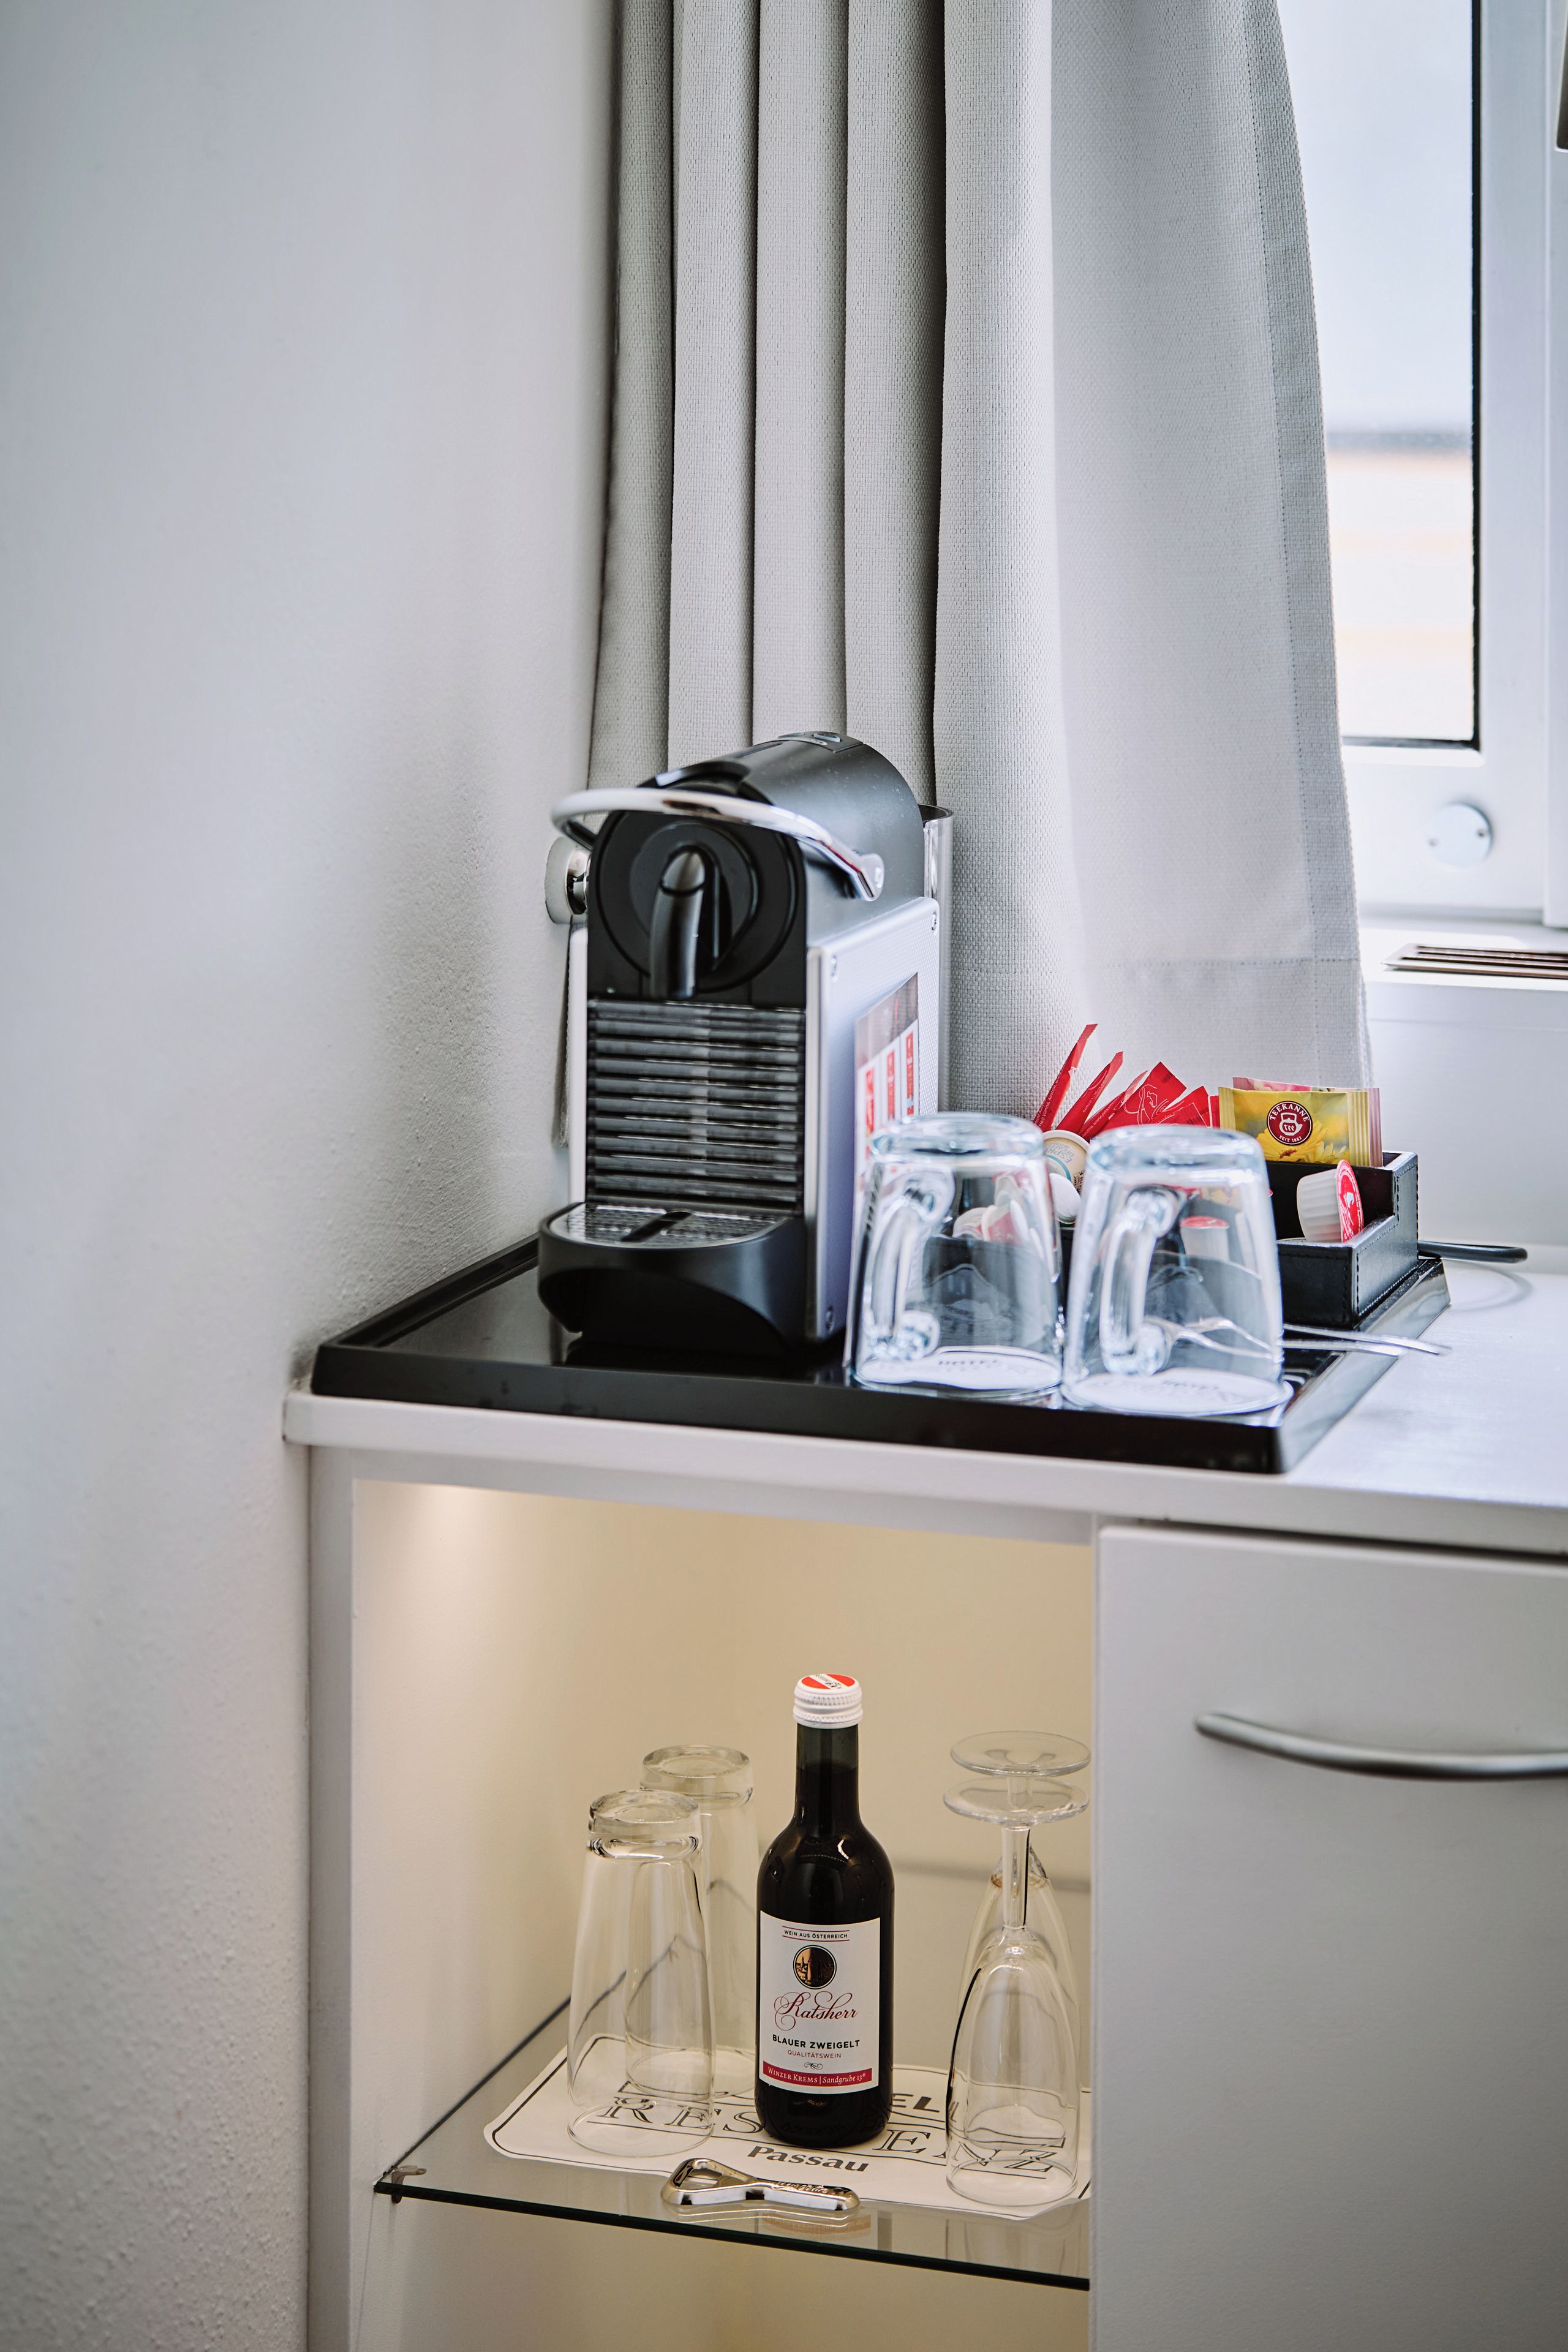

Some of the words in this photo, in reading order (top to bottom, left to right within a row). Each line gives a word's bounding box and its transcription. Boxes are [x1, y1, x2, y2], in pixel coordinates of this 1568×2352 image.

[1270, 1104, 1310, 1122] TEEKANNE
[774, 1991, 859, 2031] Ratsherr
[772, 2034, 806, 2048] BLAUER
[810, 2040, 860, 2049] ZWEIGELT
[788, 2049, 842, 2059] QUALITÄTSWEIN
[823, 2075, 856, 2085] Sandgrube
[747, 2146, 870, 2172] Passau
